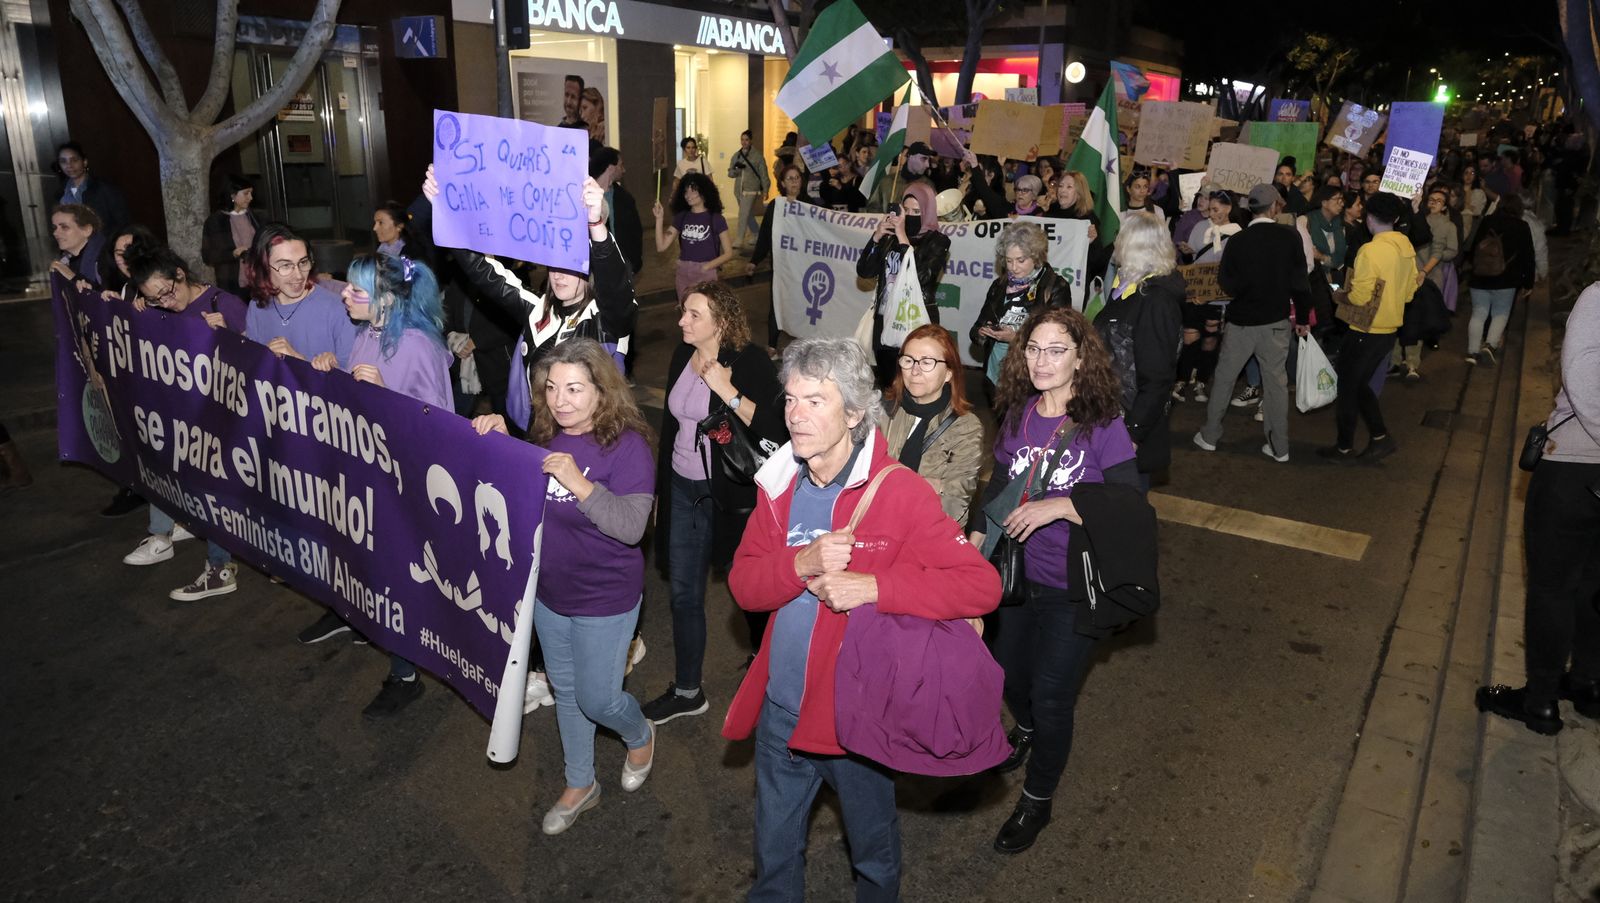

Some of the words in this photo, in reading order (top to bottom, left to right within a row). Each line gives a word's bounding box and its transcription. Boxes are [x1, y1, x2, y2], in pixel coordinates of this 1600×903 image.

[526, 0, 624, 35] BANCA
[454, 140, 486, 175] SI
[498, 139, 550, 174] QUIERES
[561, 144, 576, 156] LA
[1400, 150, 1410, 158] NO
[499, 186, 515, 206] ME
[522, 181, 579, 220] COMES
[1381, 179, 1413, 193] PROBLEMA
[478, 222, 494, 237] EL
[809, 206, 880, 231] PATRIAR
[780, 235, 798, 252] EL
[944, 260, 994, 279] HACE
[105, 315, 133, 378] ¡Si
[138, 338, 249, 417] nosotras
[254, 379, 403, 495] paramos,
[134, 405, 165, 451] se
[172, 418, 228, 480] para
[232, 436, 263, 493] el
[268, 458, 374, 551] mundo!
[136, 454, 208, 522] Asamblea
[205, 493, 295, 568] Feminista
[298, 538, 331, 585] 8M
[333, 556, 405, 635] Almería
